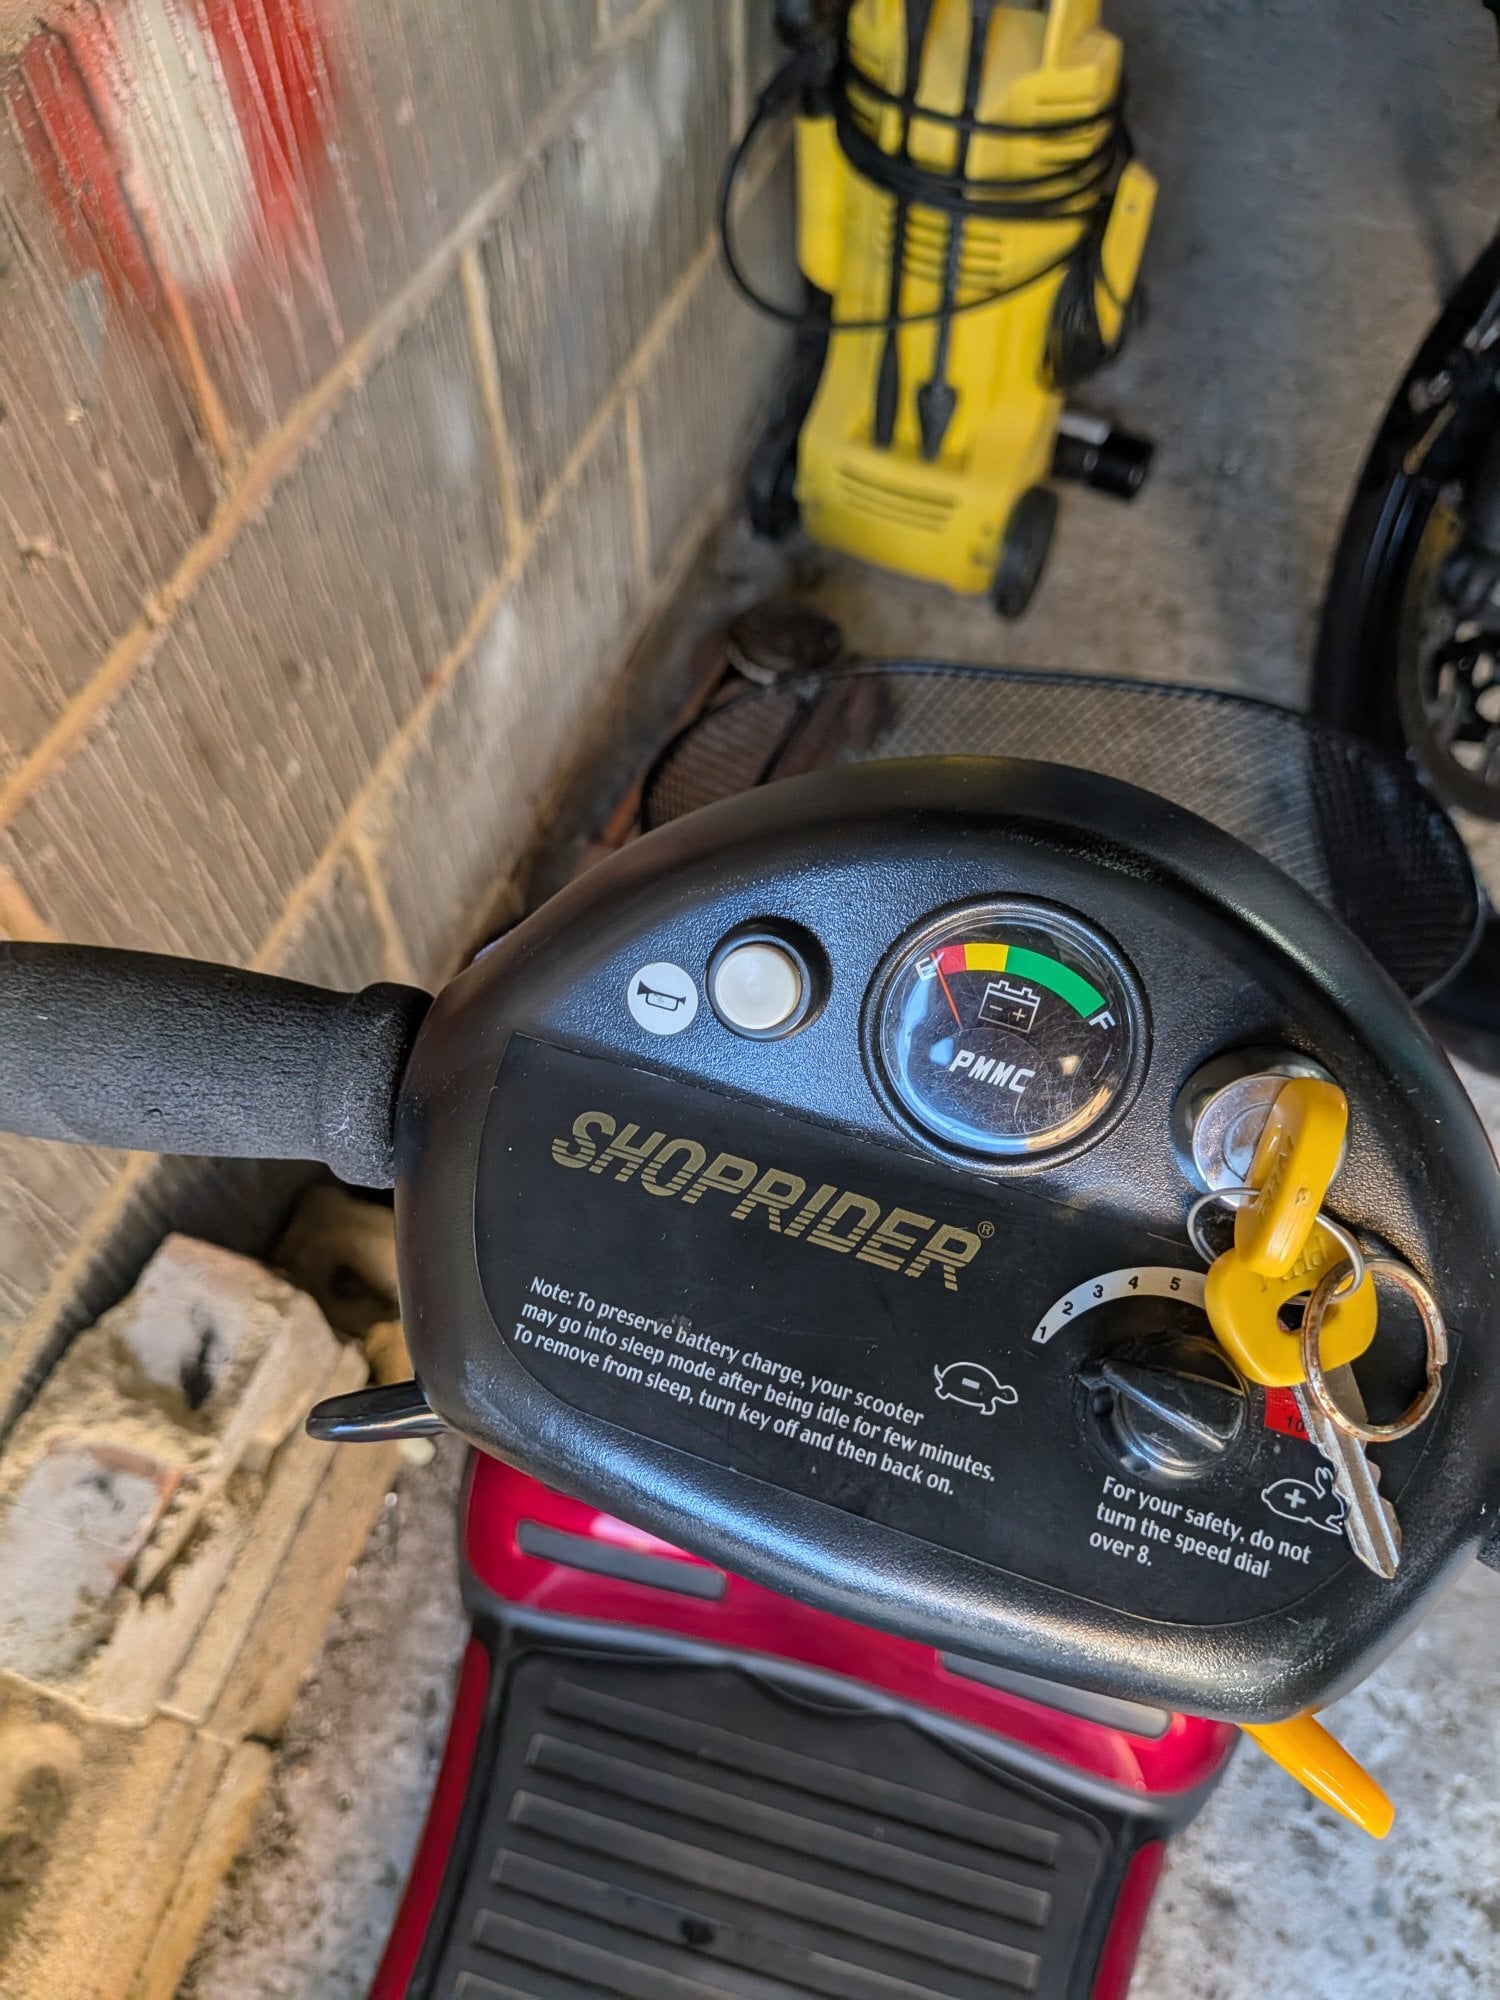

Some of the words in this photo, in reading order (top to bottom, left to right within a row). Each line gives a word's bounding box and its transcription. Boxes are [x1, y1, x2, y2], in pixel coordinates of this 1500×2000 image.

[1088, 1010, 1116, 1031] F
[949, 1049, 1036, 1094] PMMC
[552, 1110, 983, 1292] SHOPRIDER
[1038, 1325, 1047, 1339] 1
[1061, 1301, 1074, 1316] 2
[1092, 1284, 1104, 1299] 3
[1127, 1275, 1139, 1290] 4
[1169, 1276, 1182, 1291] 5
[530, 1276, 575, 1306] Note:
[576, 1291, 596, 1313] To
[596, 1302, 673, 1339] preserve
[674, 1325, 740, 1365] battery
[741, 1351, 806, 1389] charge,
[810, 1375, 853, 1401] your
[853, 1391, 925, 1426] scooter
[513, 1322, 533, 1344] To
[534, 1334, 600, 1368] remove
[601, 1354, 644, 1384] from
[644, 1372, 694, 1405] sleep,
[698, 1388, 736, 1417] turn
[738, 1402, 772, 1431] key
[773, 1418, 801, 1438] off
[799, 1428, 835, 1452] and
[836, 1437, 878, 1467] then
[880, 1452, 924, 1484] back
[926, 1473, 954, 1496] on.
[521, 1303, 559, 1328] may
[557, 1316, 582, 1334] go
[583, 1324, 618, 1347] into
[618, 1335, 665, 1366] sleep
[666, 1353, 716, 1382] mode
[718, 1371, 763, 1397] after
[763, 1383, 814, 1419] being
[816, 1405, 850, 1429] idle
[852, 1415, 882, 1439] for
[882, 1426, 918, 1452] few
[918, 1442, 995, 1482] minutes.
[1286, 1415, 1305, 1433] 10
[1089, 1532, 1135, 1558] over
[1136, 1544, 1152, 1566] 8.
[1096, 1501, 1137, 1532] turn
[1140, 1517, 1172, 1544] the
[1174, 1533, 1232, 1565] speed
[1233, 1551, 1270, 1578] dial
[1102, 1477, 1136, 1502] For
[1138, 1491, 1183, 1518] your
[1184, 1508, 1246, 1545] safety,
[1249, 1529, 1275, 1551] do
[1277, 1540, 1312, 1564] not
